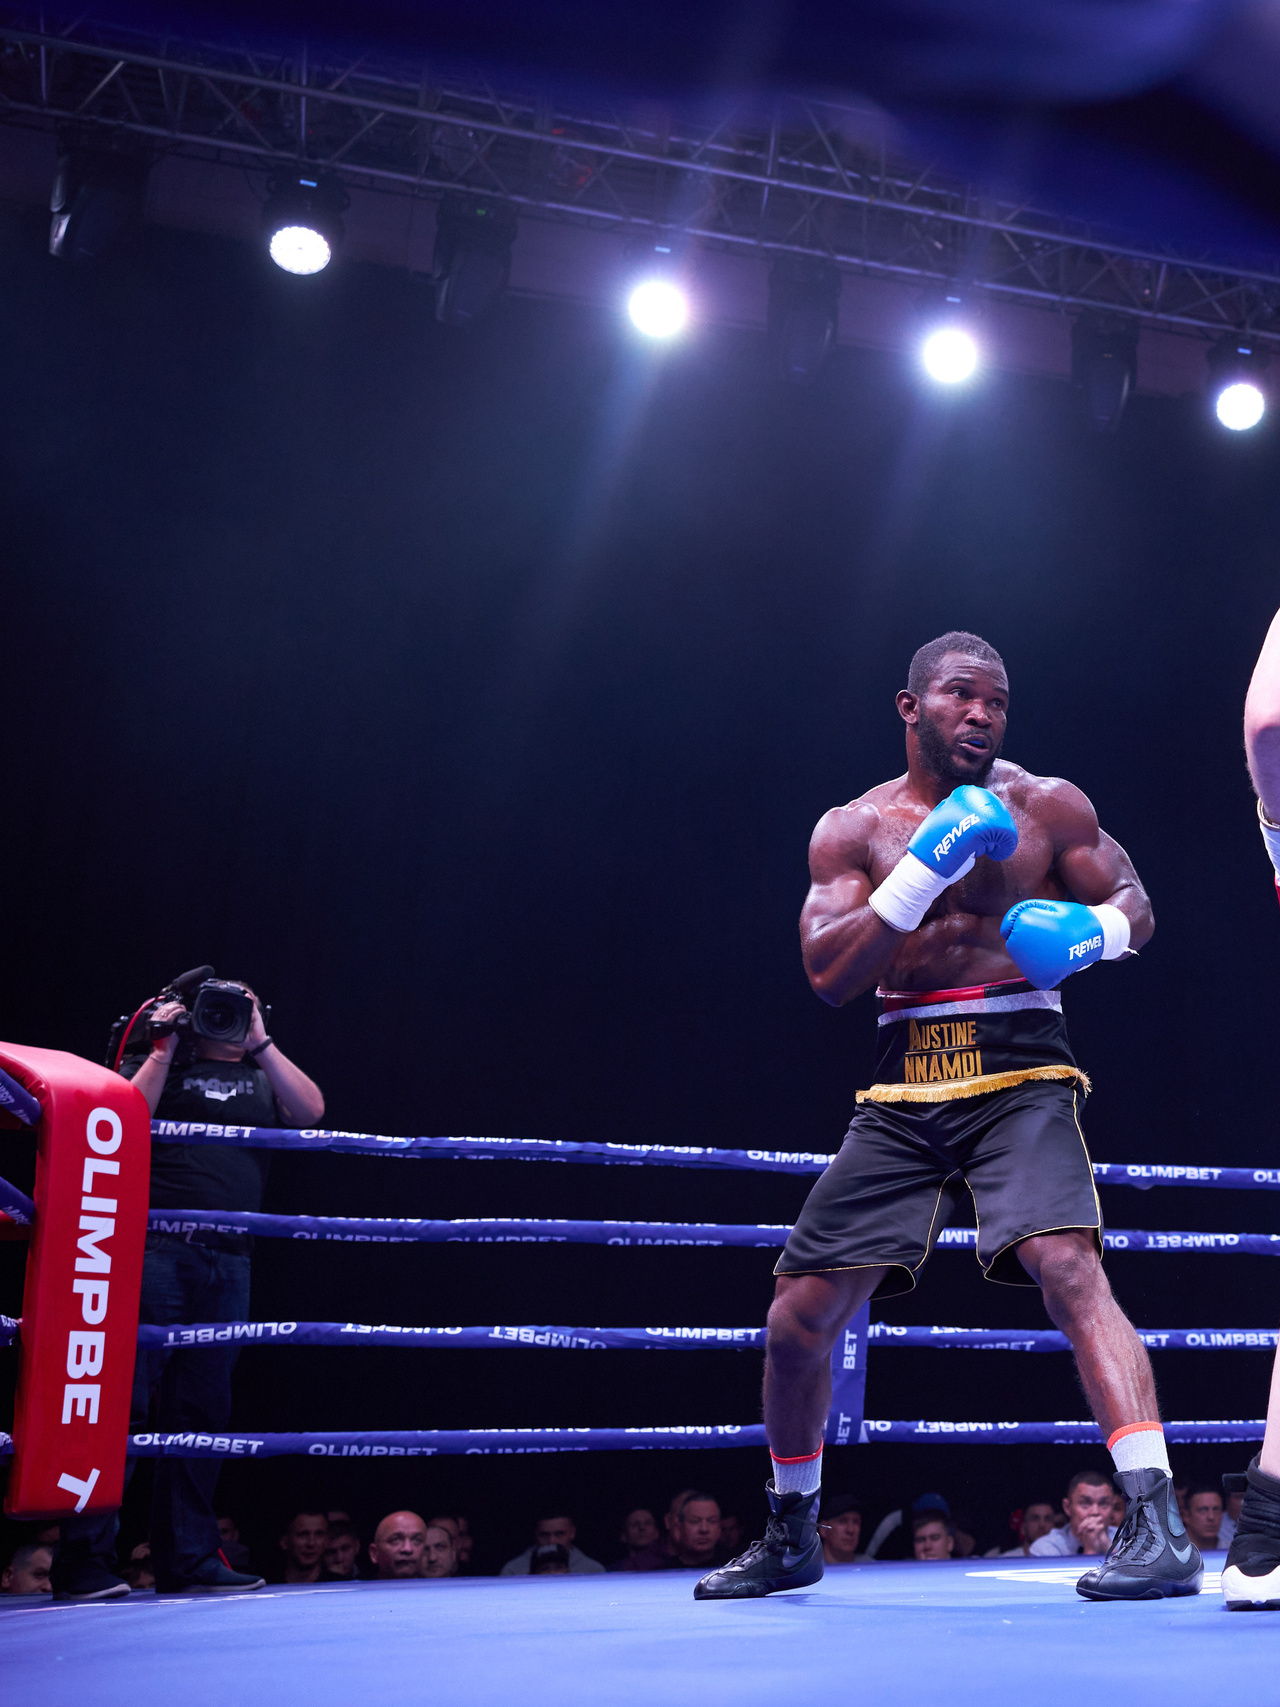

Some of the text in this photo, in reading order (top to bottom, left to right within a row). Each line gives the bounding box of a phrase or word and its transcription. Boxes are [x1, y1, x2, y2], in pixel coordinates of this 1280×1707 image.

[909, 1019, 976, 1050] AUSTINE
[904, 1050, 982, 1083] NNAMDI
[150, 1122, 256, 1138] IMPBET
[1127, 1165, 1222, 1180] OLIMPBET
[1145, 1235, 1239, 1249] OLIMPBET
[163, 1322, 297, 1346] OLIMPBET
[133, 1433, 264, 1454] OLIMPBET
